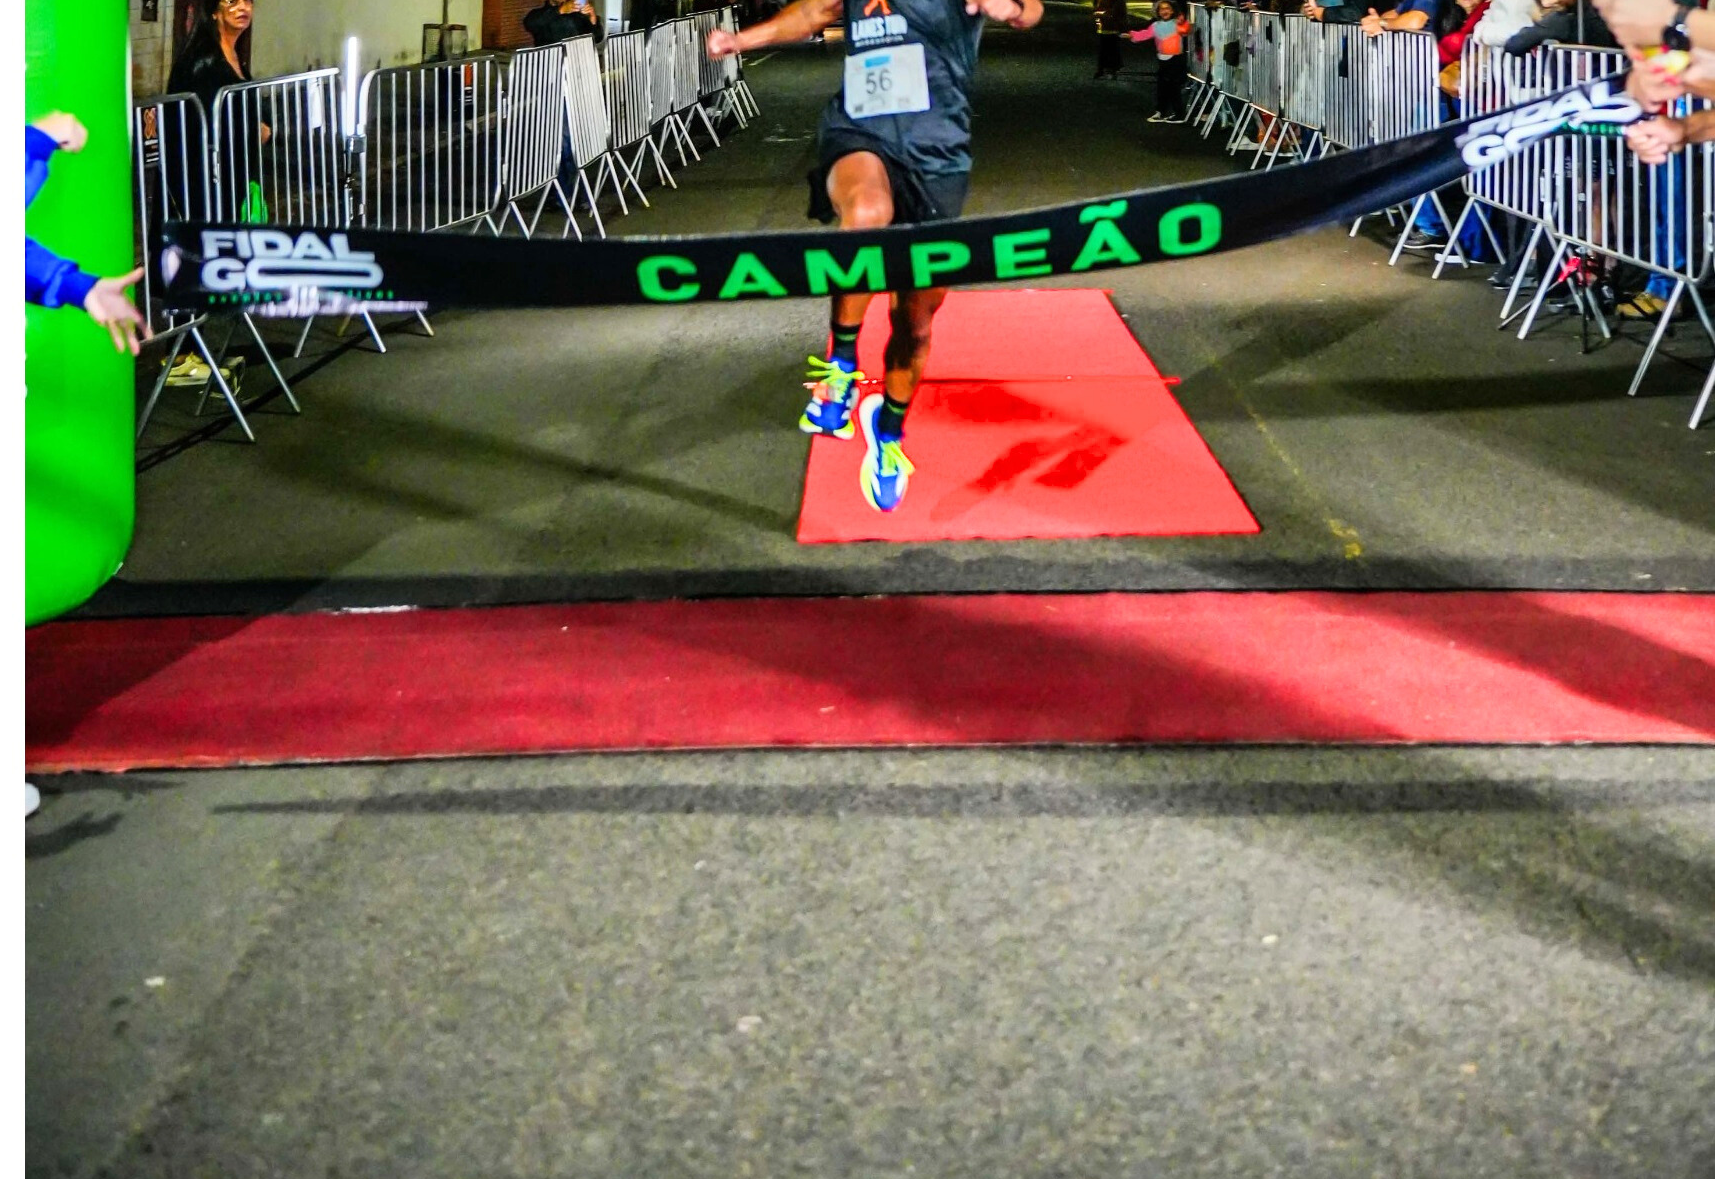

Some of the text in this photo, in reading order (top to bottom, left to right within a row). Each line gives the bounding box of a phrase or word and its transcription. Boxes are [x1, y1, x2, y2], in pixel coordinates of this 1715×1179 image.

[865, 69, 893, 95] 56
[200, 230, 375, 261] FIDAL
[637, 196, 1222, 301] CAMPEÃO
